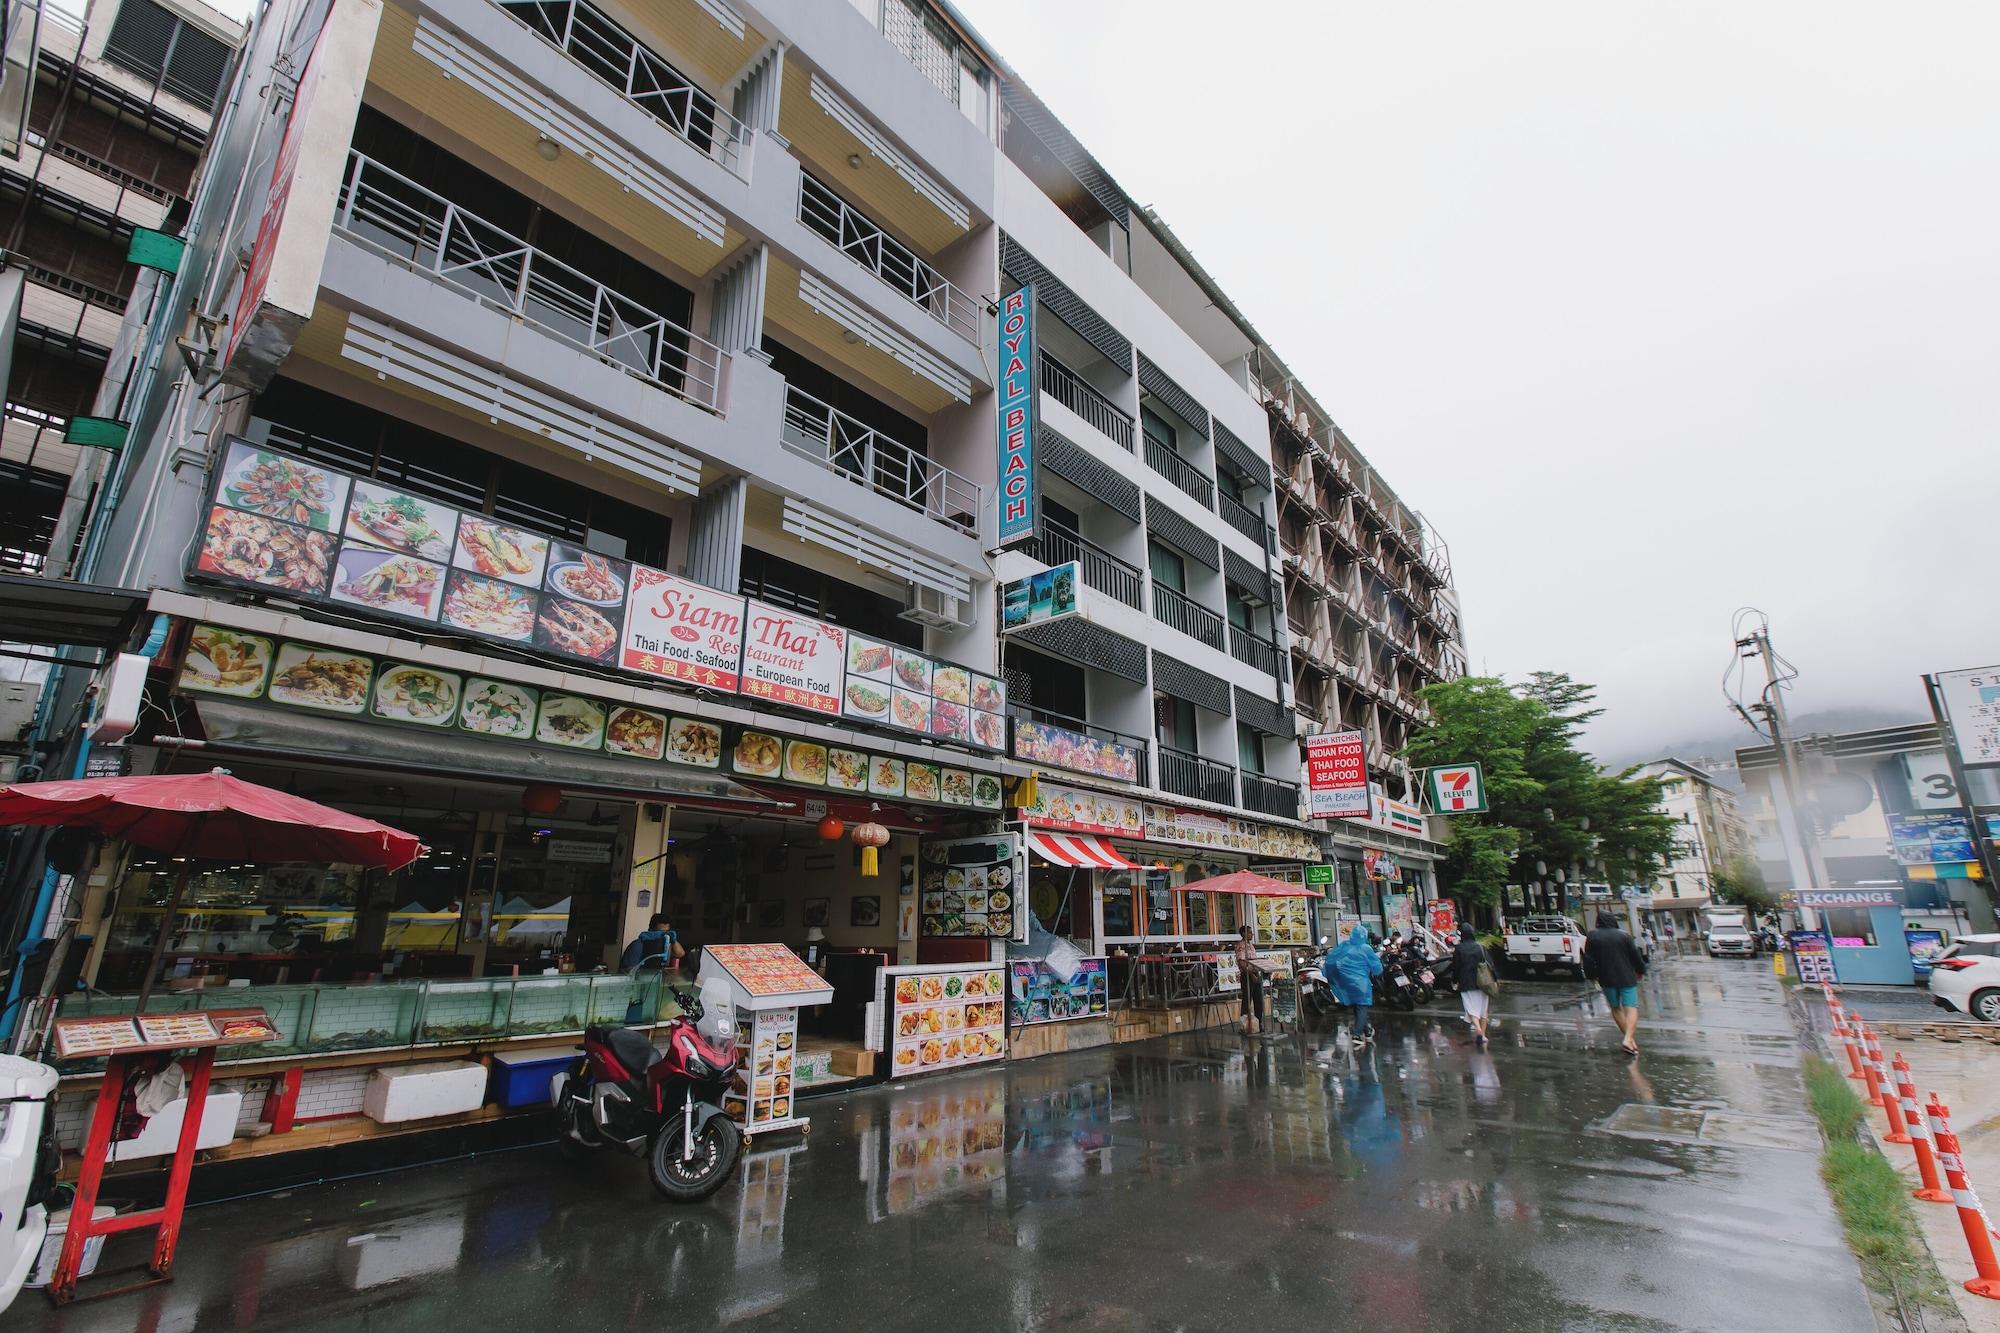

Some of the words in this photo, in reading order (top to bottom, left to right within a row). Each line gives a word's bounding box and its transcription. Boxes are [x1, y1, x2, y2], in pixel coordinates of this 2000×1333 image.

[1003, 293, 1025, 400] ROYAL
[1004, 408, 1028, 522] BEACH
[651, 589, 740, 636] Siam
[753, 616, 821, 657] Thai
[634, 634, 659, 653] Thai
[756, 665, 803, 688] European
[807, 678, 830, 694] Food
[1330, 735, 1361, 744] KITCHEN
[1309, 747, 1337, 758] INDIAN
[1338, 744, 1362, 756] FOOD
[1313, 761, 1334, 770] THAI
[1335, 757, 1360, 768] FOOD
[1316, 770, 1358, 781] SEAFOOD
[1441, 772, 1470, 810] 7
[1921, 774, 1957, 799] 3
[1314, 793, 1334, 802] SEA
[1335, 792, 1365, 802] BEACH
[806, 802, 825, 814] 64/40
[1311, 868, 1330, 877] حلال
[1104, 887, 1120, 896] INDIAN
[1120, 888, 1131, 896] FOOD
[1803, 892, 1893, 904] EXCHANGE
[760, 1014, 774, 1024] SIAM
[776, 1013, 789, 1022] THAI
